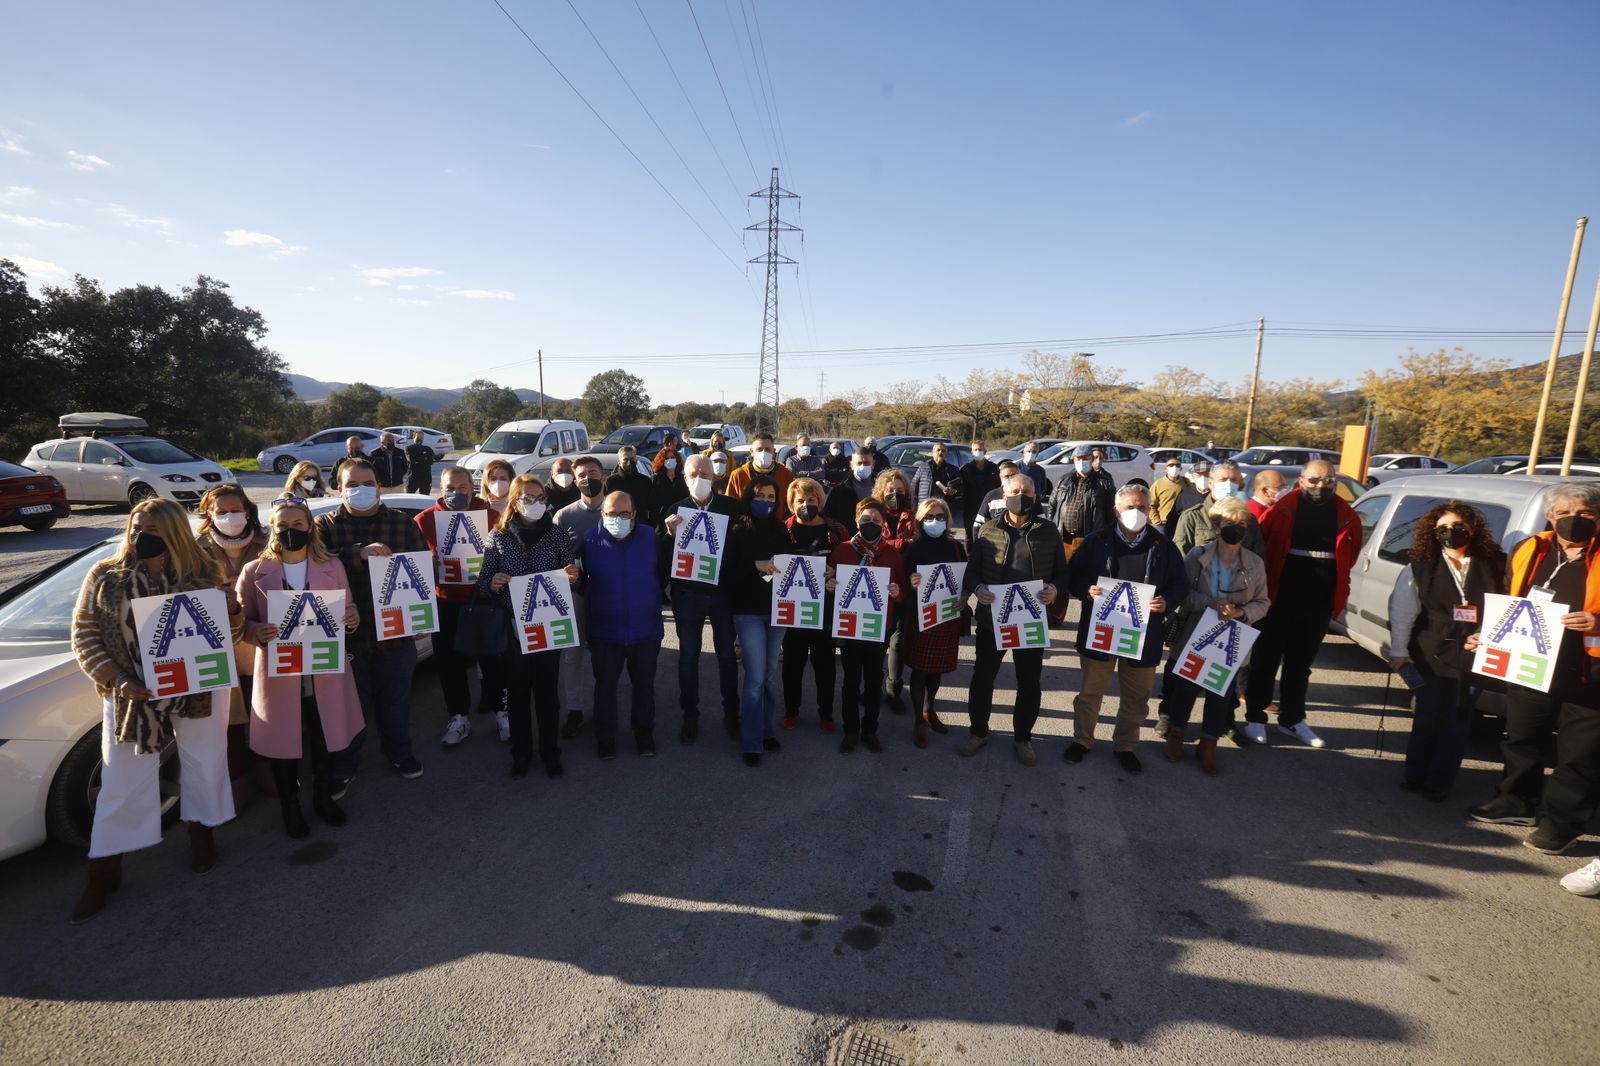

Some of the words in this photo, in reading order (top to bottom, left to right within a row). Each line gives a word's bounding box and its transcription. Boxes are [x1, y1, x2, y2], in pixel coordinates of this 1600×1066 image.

[440, 514, 456, 553] PLATAFORMA
[677, 512, 699, 546] PLATAFORMA
[379, 557, 396, 604] PLATAFORMA
[407, 557, 431, 595] CIUDADANA
[545, 576, 570, 611] CIUDADANA
[776, 557, 796, 595] PLATAFORMA
[805, 560, 821, 595] CIUDADANA
[838, 568, 859, 606] PLATAFORMA
[869, 571, 884, 607] CIUDADANA
[316, 595, 340, 633] CIUDADANA
[520, 577, 534, 621] PLATAFORMA
[997, 587, 1012, 622] PLATAFORMA
[1022, 585, 1043, 615] CIUDADANA
[1096, 582, 1122, 618] PLATAFORMA
[1132, 586, 1144, 623] CIUDADANA
[149, 598, 174, 655] PLATAFORMA
[191, 597, 225, 642] CIUDADANA
[1487, 600, 1520, 640] PLATAFORMA
[1535, 605, 1552, 650] CIUDADANA
[1232, 627, 1241, 663] CIUDADANA
